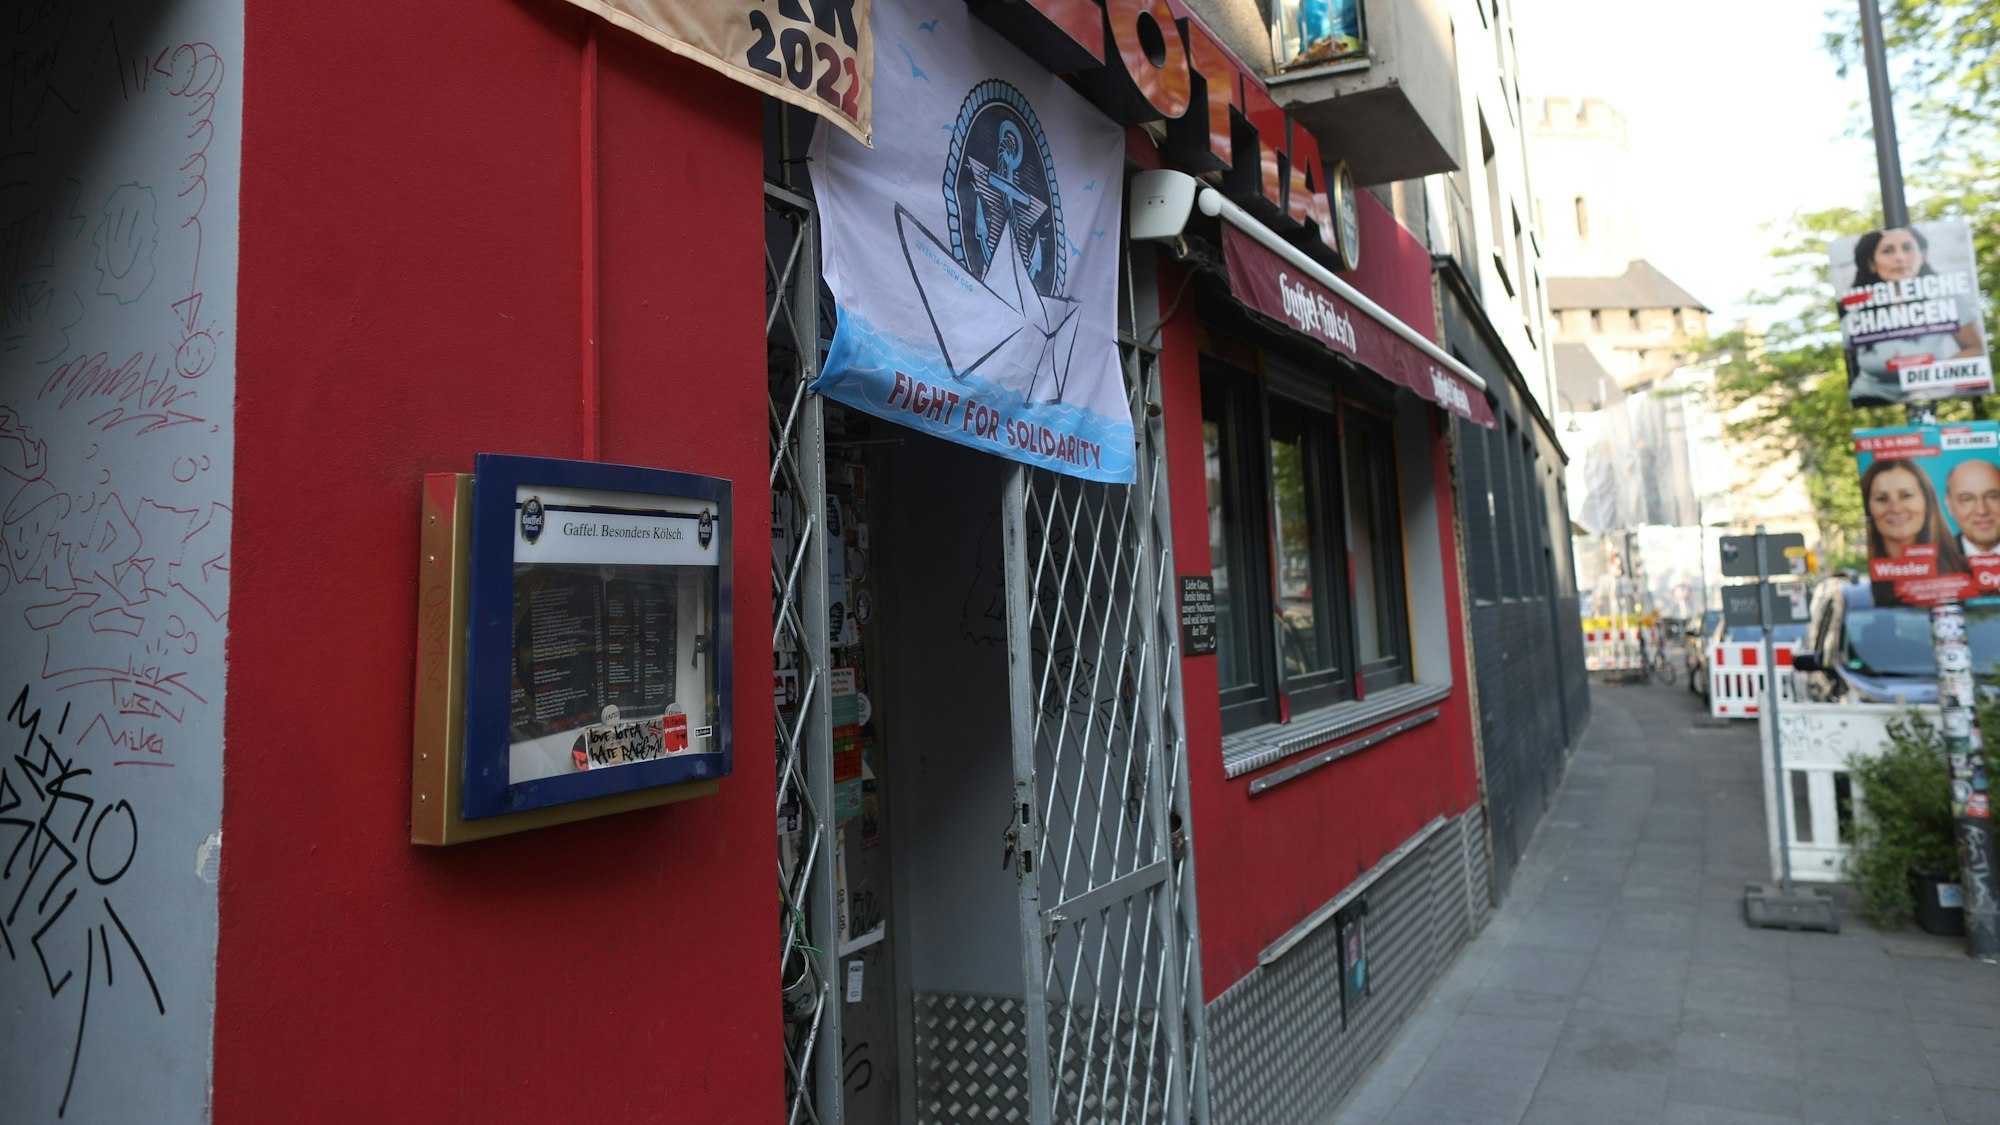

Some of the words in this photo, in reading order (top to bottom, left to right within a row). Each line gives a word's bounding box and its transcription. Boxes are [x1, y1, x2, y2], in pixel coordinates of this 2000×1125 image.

[747, 10, 859, 122] 2022
[1847, 298, 1959, 335] CHANCEN
[1907, 371, 1930, 383] DIE
[887, 371, 959, 426] FIGHT
[963, 400, 1000, 442] FOR
[1006, 416, 1101, 470] SOLIDARITY
[563, 523, 599, 537] Gaffel.
[601, 525, 650, 539] Besonders
[653, 527, 684, 540] Kölsch.
[1874, 562, 1930, 576] Wissler
